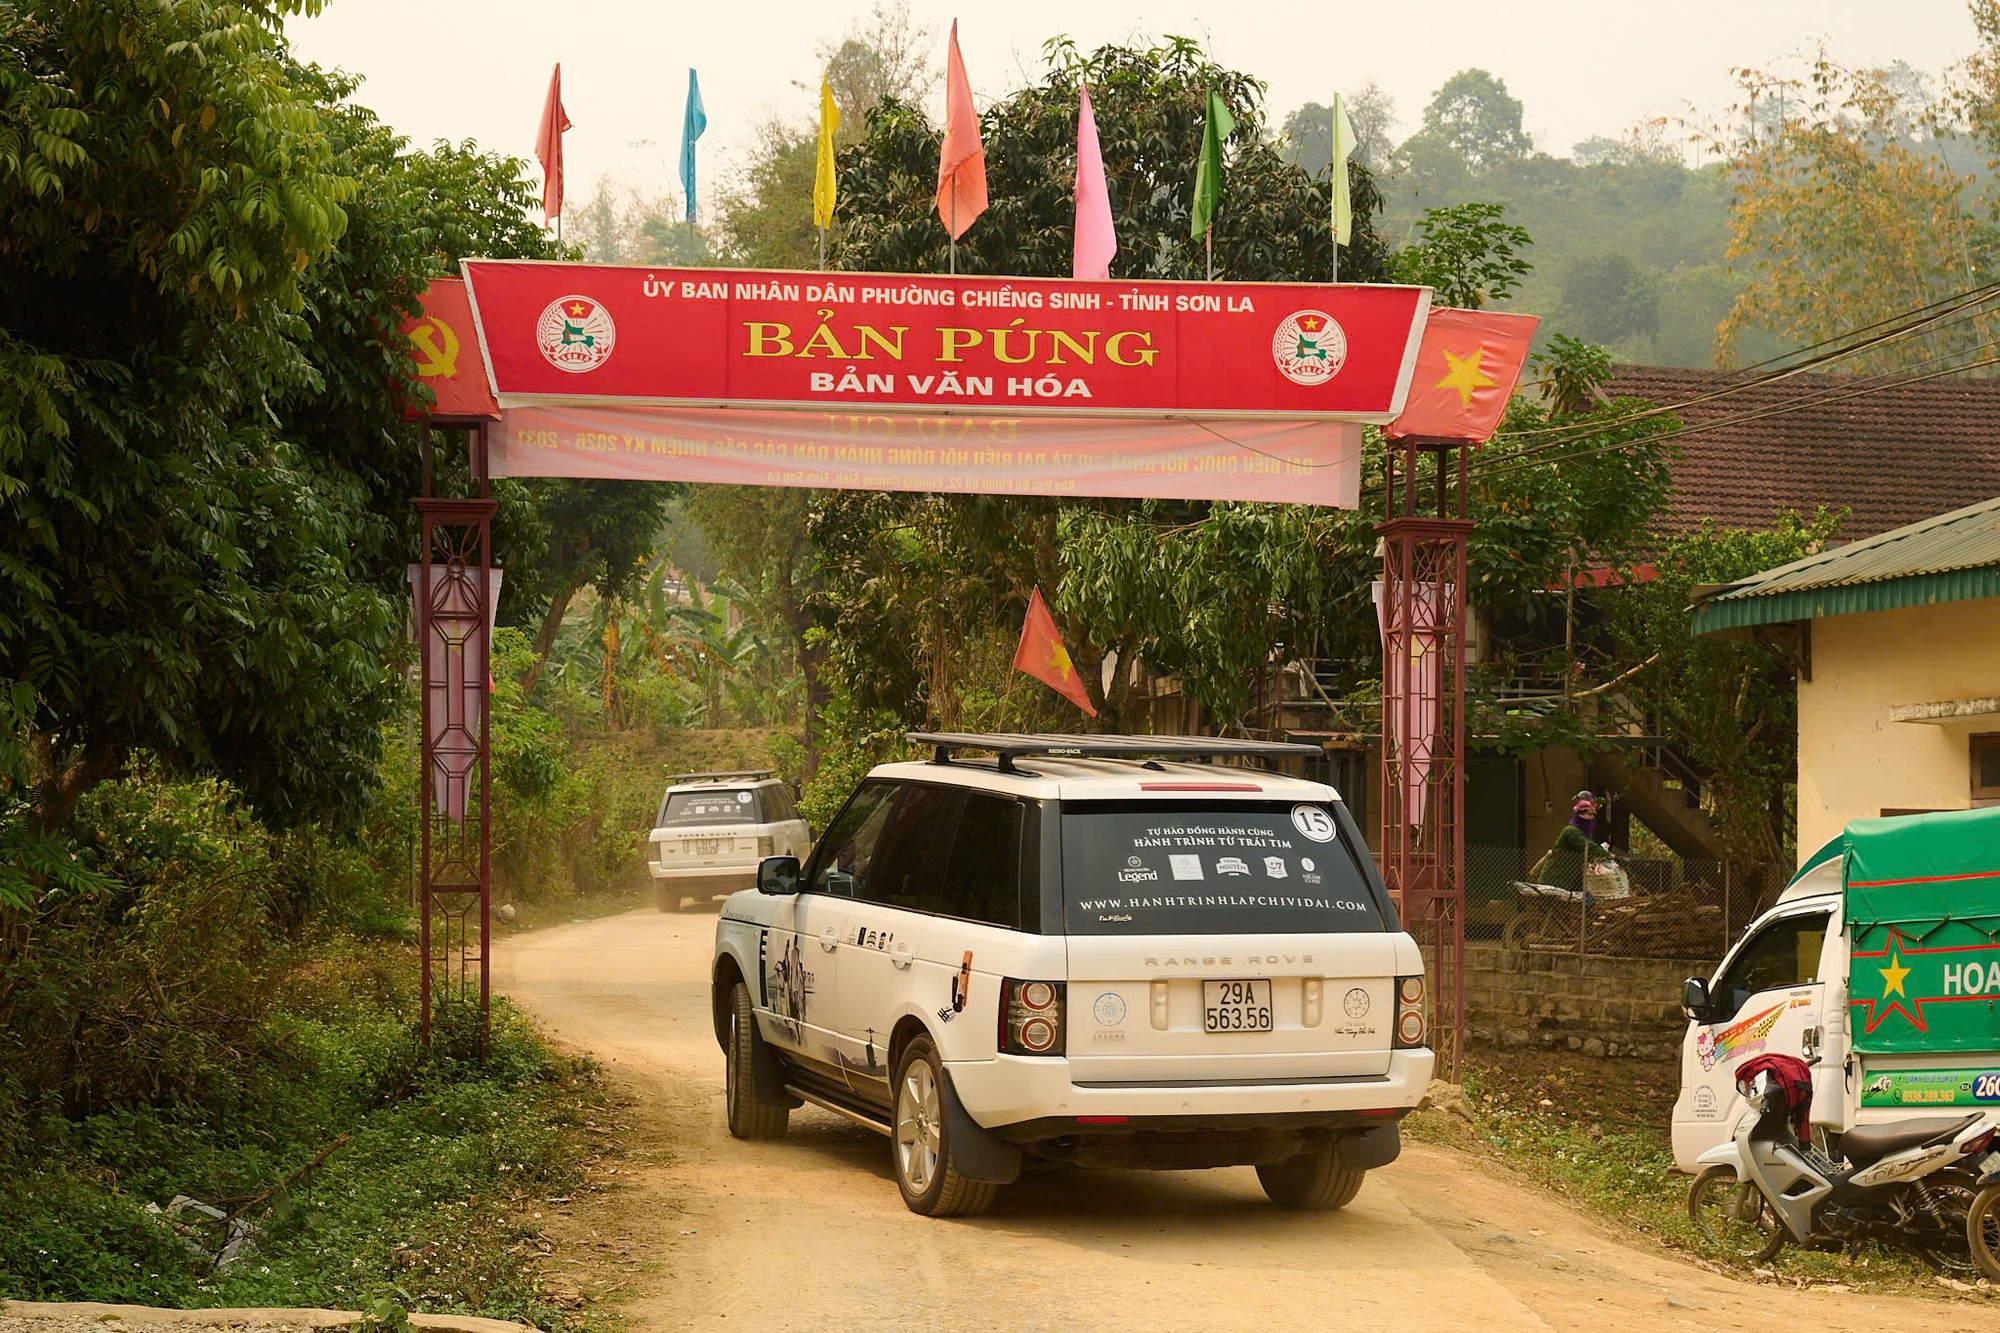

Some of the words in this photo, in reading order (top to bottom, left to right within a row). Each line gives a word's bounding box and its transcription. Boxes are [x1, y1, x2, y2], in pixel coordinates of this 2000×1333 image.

[643, 274, 675, 298] ỦY
[682, 282, 728, 299] BAN
[735, 280, 799, 301] NHÂN
[806, 282, 854, 303] DÂN
[862, 284, 955, 306] PHƯỜNG
[962, 284, 1043, 308] CHIỀNG
[1050, 292, 1100, 310] SINH
[1119, 287, 1169, 311] TỈNH
[1175, 294, 1221, 312] SƠN
[1227, 296, 1255, 312] LA
[742, 308, 910, 361] BẢN
[934, 317, 1160, 367] PÚNG
[810, 365, 894, 394] BẢN
[907, 370, 993, 395] VĂN
[1007, 373, 1092, 398] HÓA
[1147, 827, 1161, 836] TỰ
[1163, 826, 1184, 836] HÀO
[1218, 827, 1245, 836] HÀNH
[1297, 811, 1328, 834] 15
[1134, 836, 1171, 847] HÀNH
[1174, 835, 1215, 846] TRÌNH
[1217, 835, 1235, 846] TỪ
[1237, 837, 1266, 848] TRÁI
[1268, 839, 1293, 849] TIM
[1118, 870, 1158, 884] Legend
[1080, 896, 1367, 912] WWW.HANHTRINHLAPCHIVIDAI.COM
[1144, 956, 1232, 966] RANGE
[1249, 955, 1314, 964] ROVE
[1220, 982, 1255, 1005] 29A
[1206, 1007, 1270, 1029] 563.56
